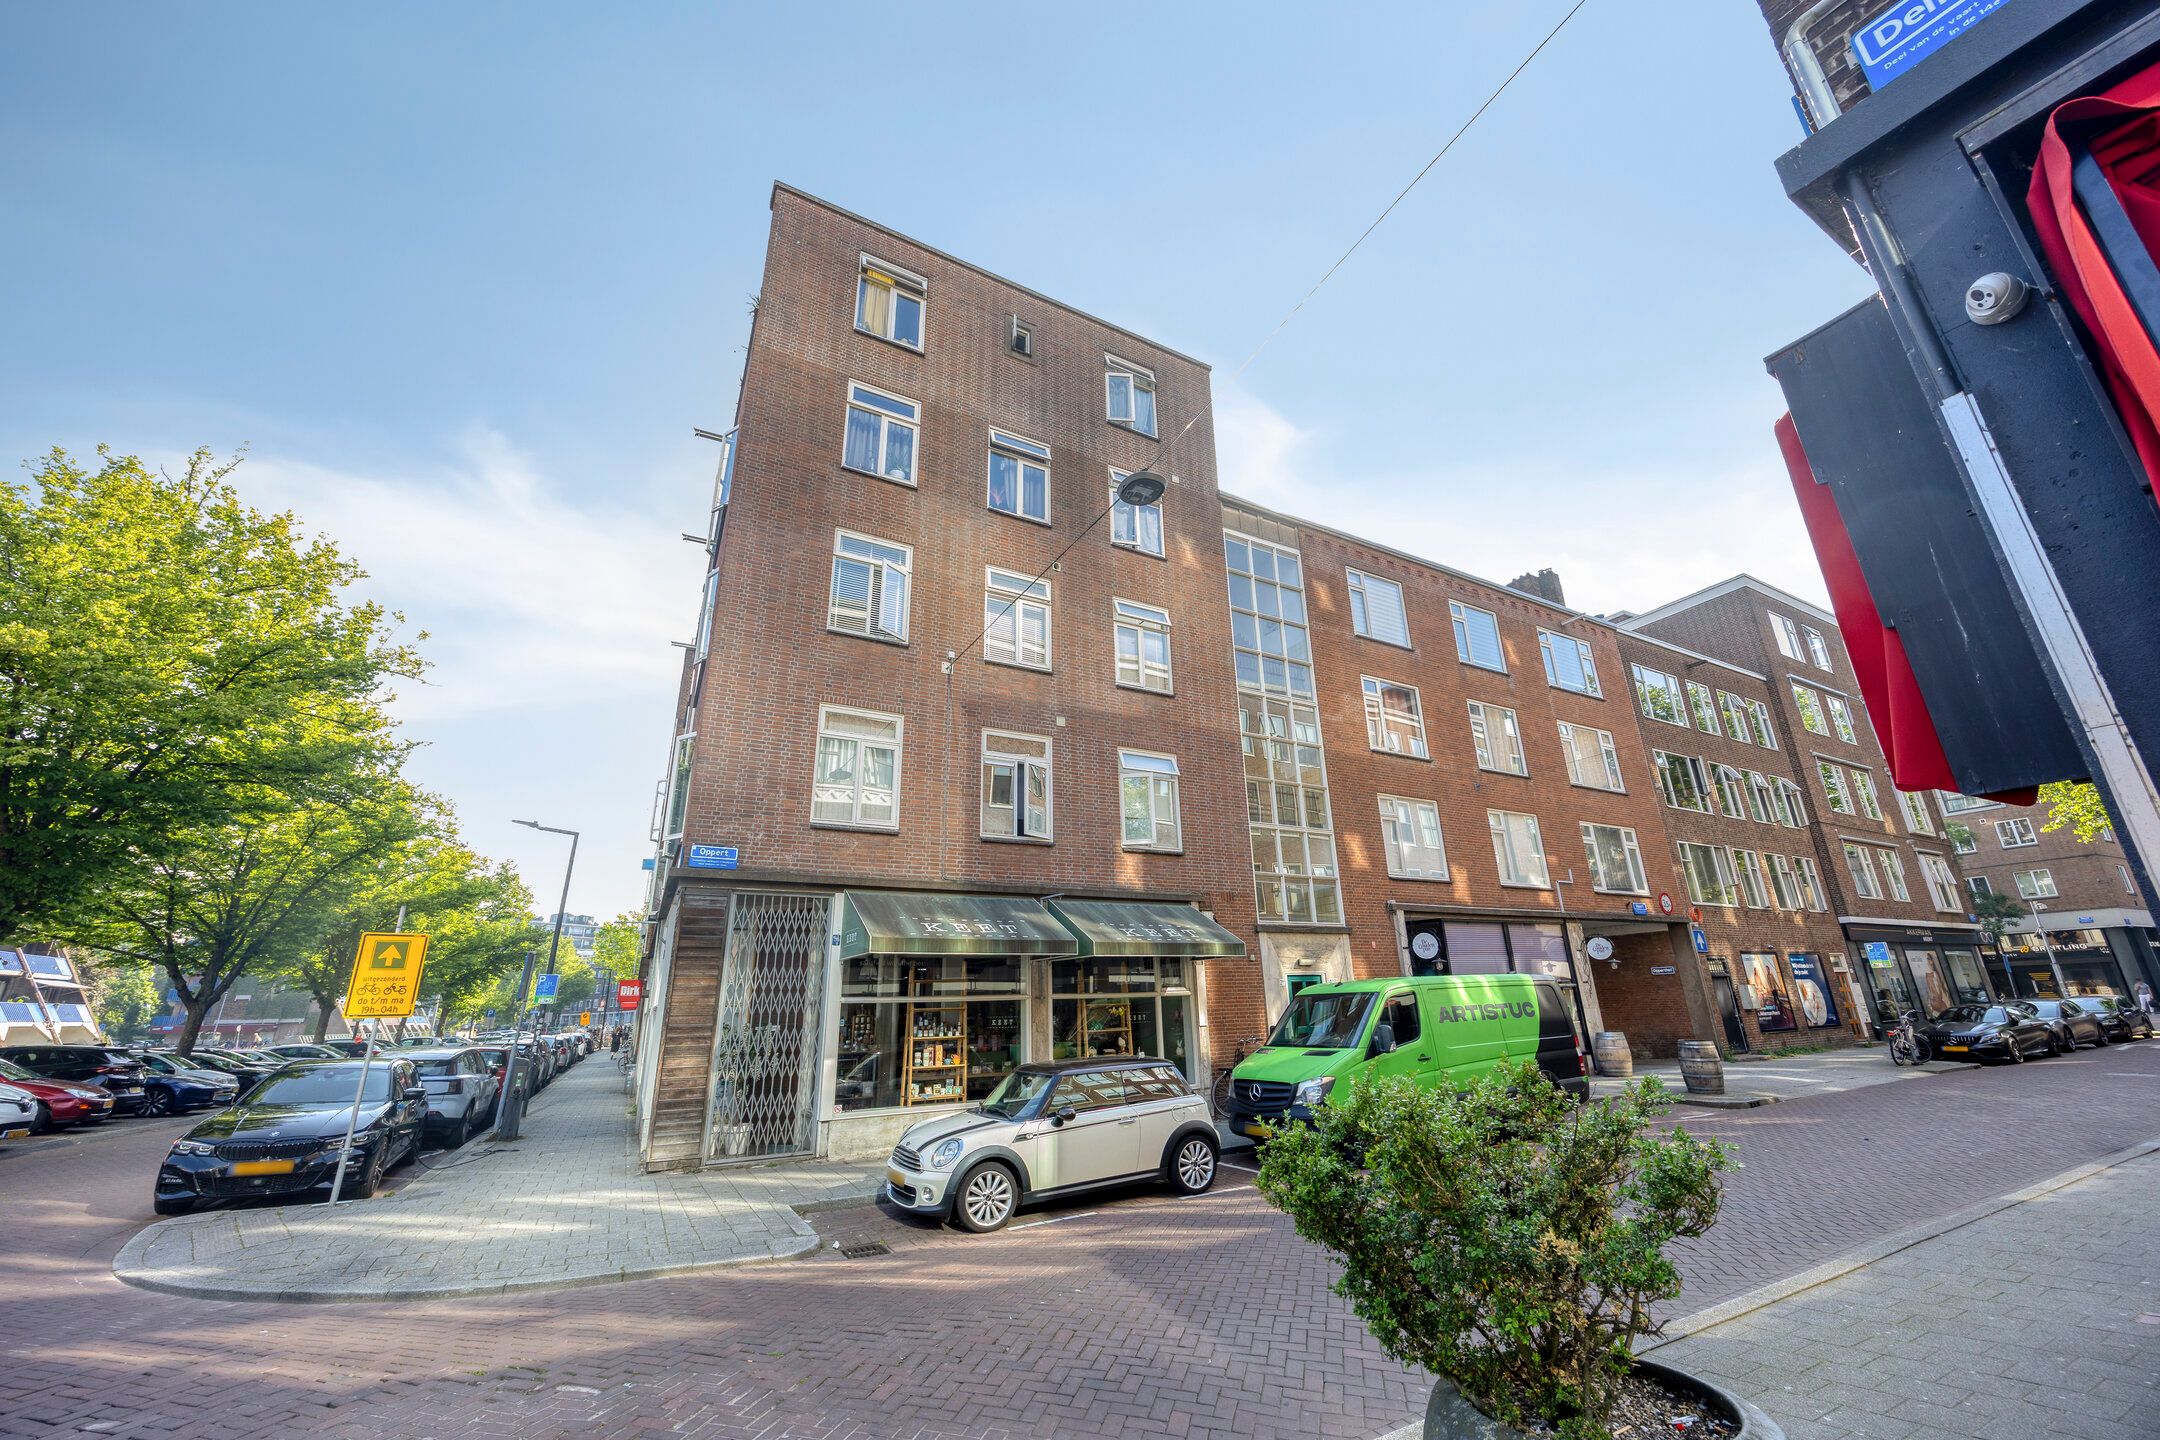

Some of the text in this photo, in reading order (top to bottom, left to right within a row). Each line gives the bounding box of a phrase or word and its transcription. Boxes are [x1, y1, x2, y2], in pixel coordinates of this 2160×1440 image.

[1873, 0, 1950, 48] Del
[1962, 16, 1977, 28] de
[1884, 1, 1981, 70] Deel van de vaart
[699, 847, 729, 857] Oppert
[921, 922, 1018, 934] KEET
[1120, 928, 1200, 938] KEET
[620, 985, 640, 997] Dirk
[357, 996, 405, 1005] do t/m ma
[1439, 1001, 1536, 1024] ARTISTUC
